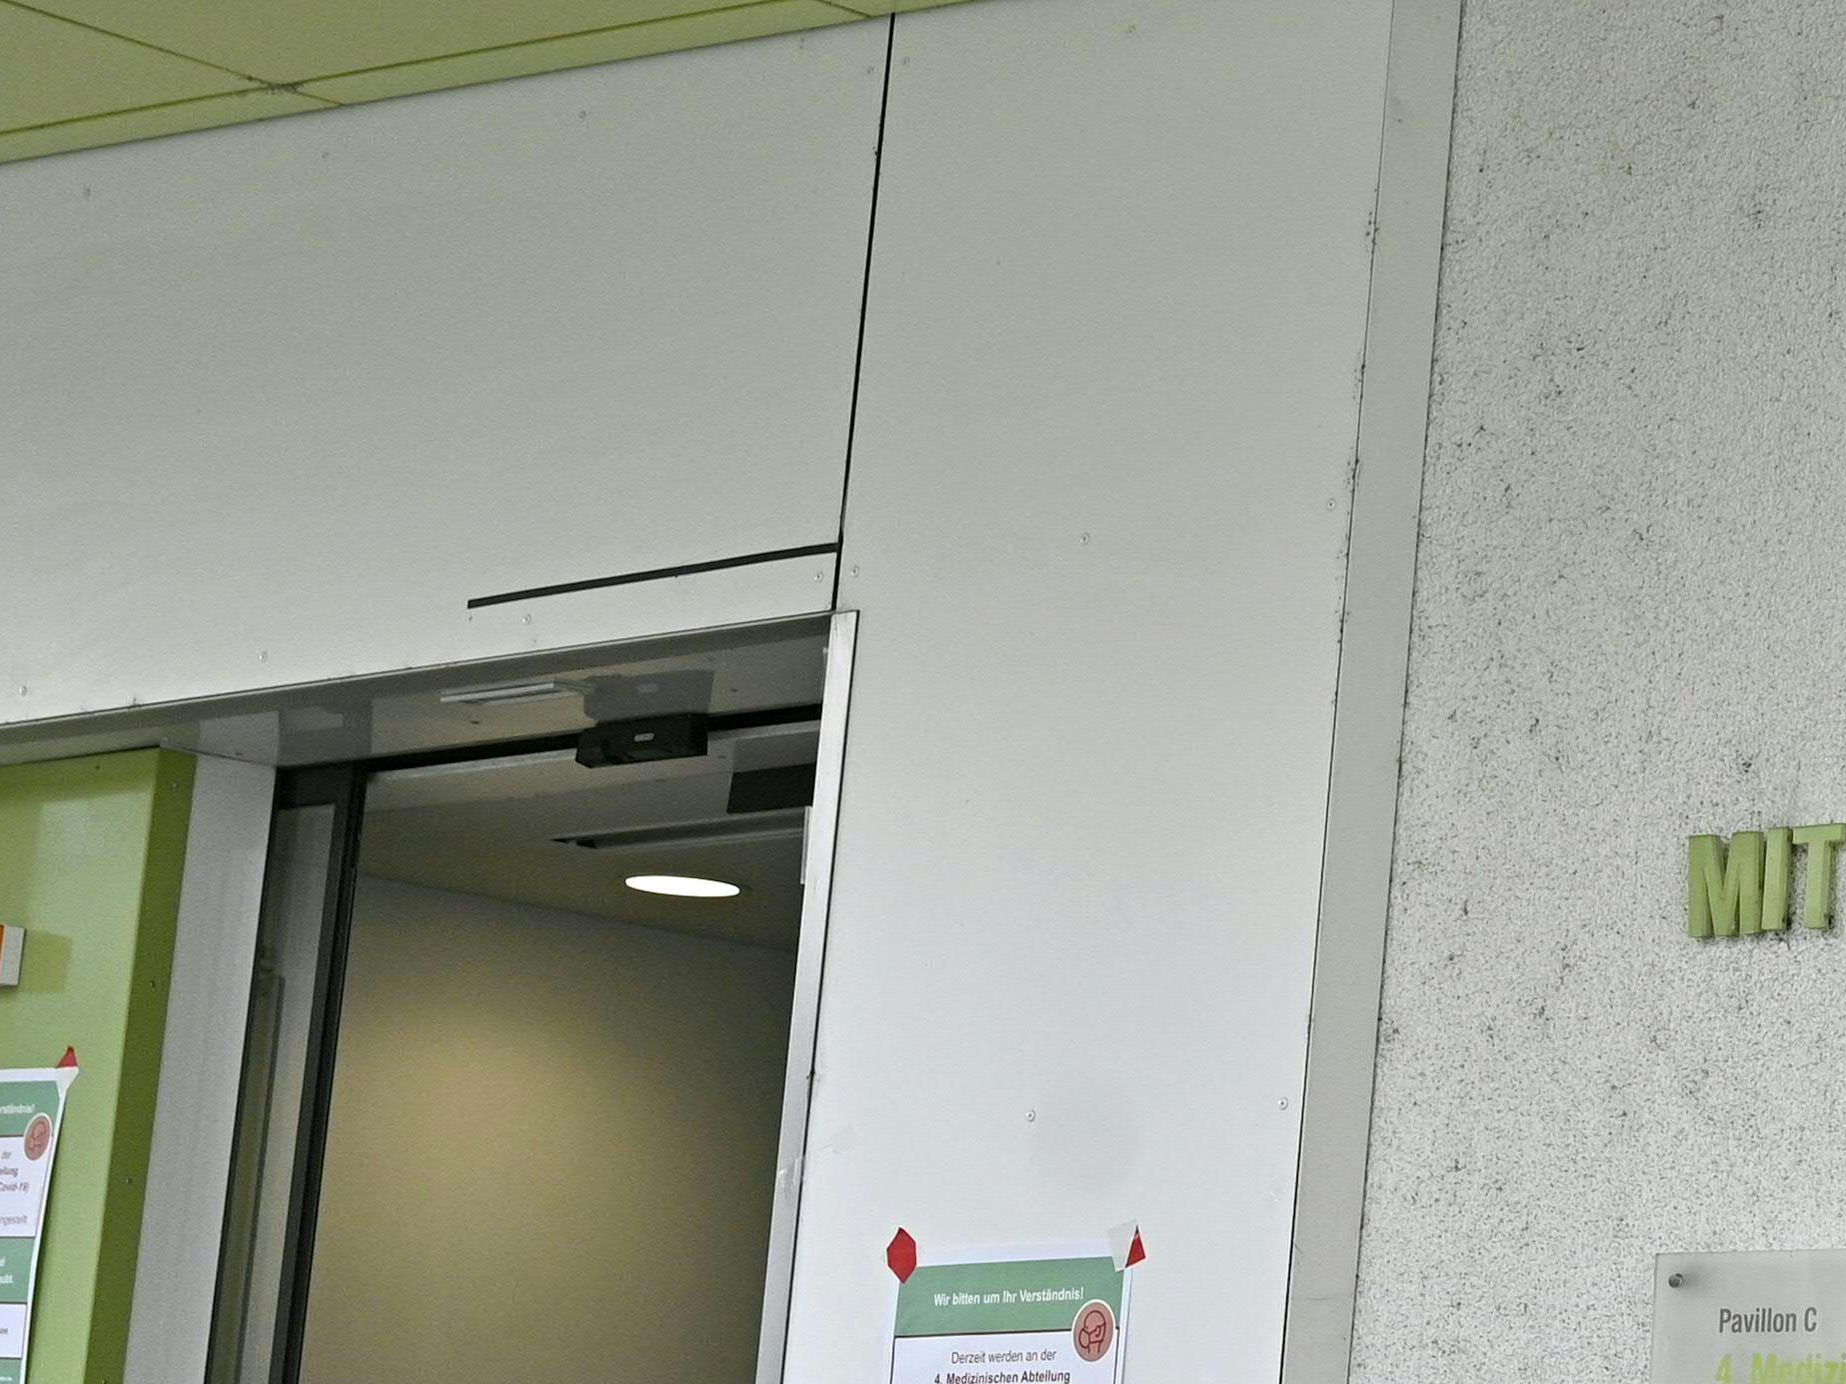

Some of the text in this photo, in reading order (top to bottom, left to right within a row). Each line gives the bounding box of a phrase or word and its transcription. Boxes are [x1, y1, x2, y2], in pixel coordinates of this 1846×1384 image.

[934, 1286, 1084, 1306] Wir bitten um Ihr Verständnis!
[1719, 1307, 1817, 1333] Pavillon C
[952, 1349, 1056, 1364] Derzeit werden an der
[934, 1371, 1070, 1384] 4. Medizinischen Abteilung
